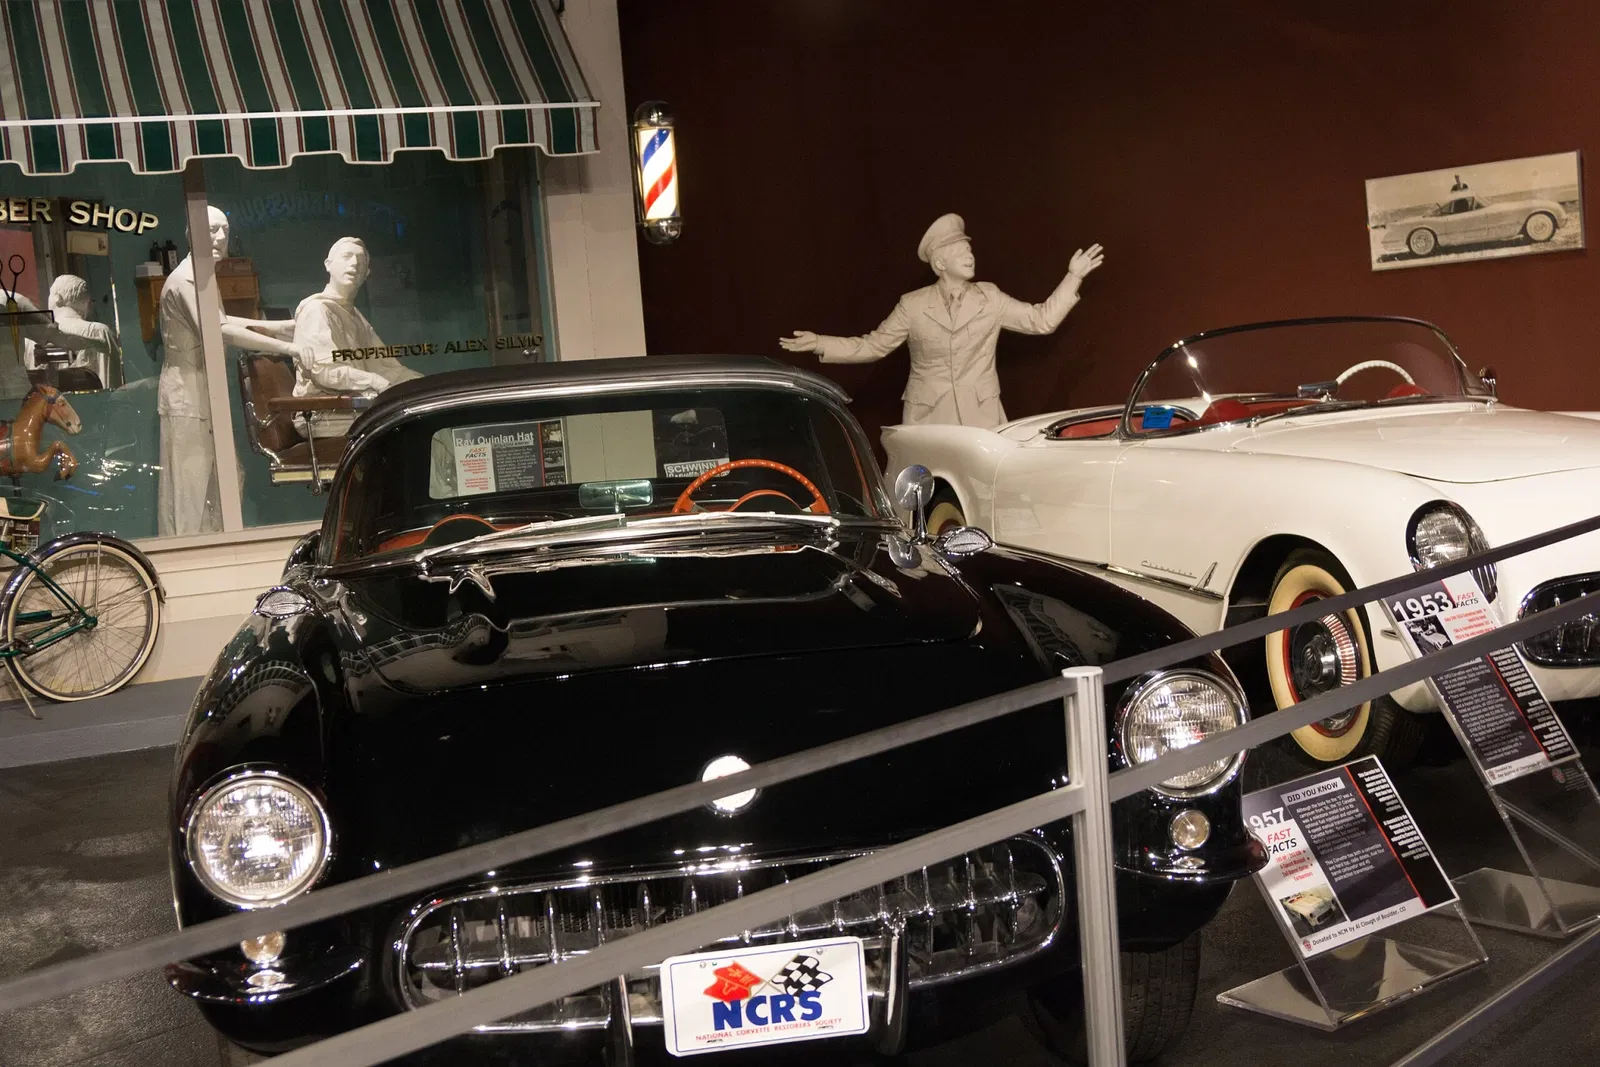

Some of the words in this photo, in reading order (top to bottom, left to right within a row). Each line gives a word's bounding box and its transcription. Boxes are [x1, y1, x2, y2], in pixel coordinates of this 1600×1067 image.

[67, 200, 160, 236] SHOP
[331, 342, 438, 362] PROPRIETOR:
[444, 338, 488, 354] ALEX
[495, 334, 544, 350] SILVIO
[477, 434, 515, 446] Quinlan
[516, 431, 534, 442] Hat
[464, 452, 487, 460] FACTS
[666, 461, 717, 473] SCHWINN
[1456, 598, 1478, 608] FACTS
[1457, 592, 1475, 600] FAST
[1393, 590, 1454, 621] 1953
[1317, 782, 1338, 792] KNOW
[1244, 806, 1286, 832] 957
[1267, 828, 1292, 844] FAST
[1267, 838, 1298, 855] FACTS
[1312, 935, 1332, 946] Donated
[1360, 918, 1376, 927] Clough
[1381, 910, 1399, 919] Boulder,
[711, 990, 823, 1032] NCRS
[695, 1030, 733, 1042] NATIONAL
[736, 1026, 770, 1037] CORVETTE
[774, 1021, 812, 1032] RESTORERS
[815, 1018, 842, 1028] SOCIETY
